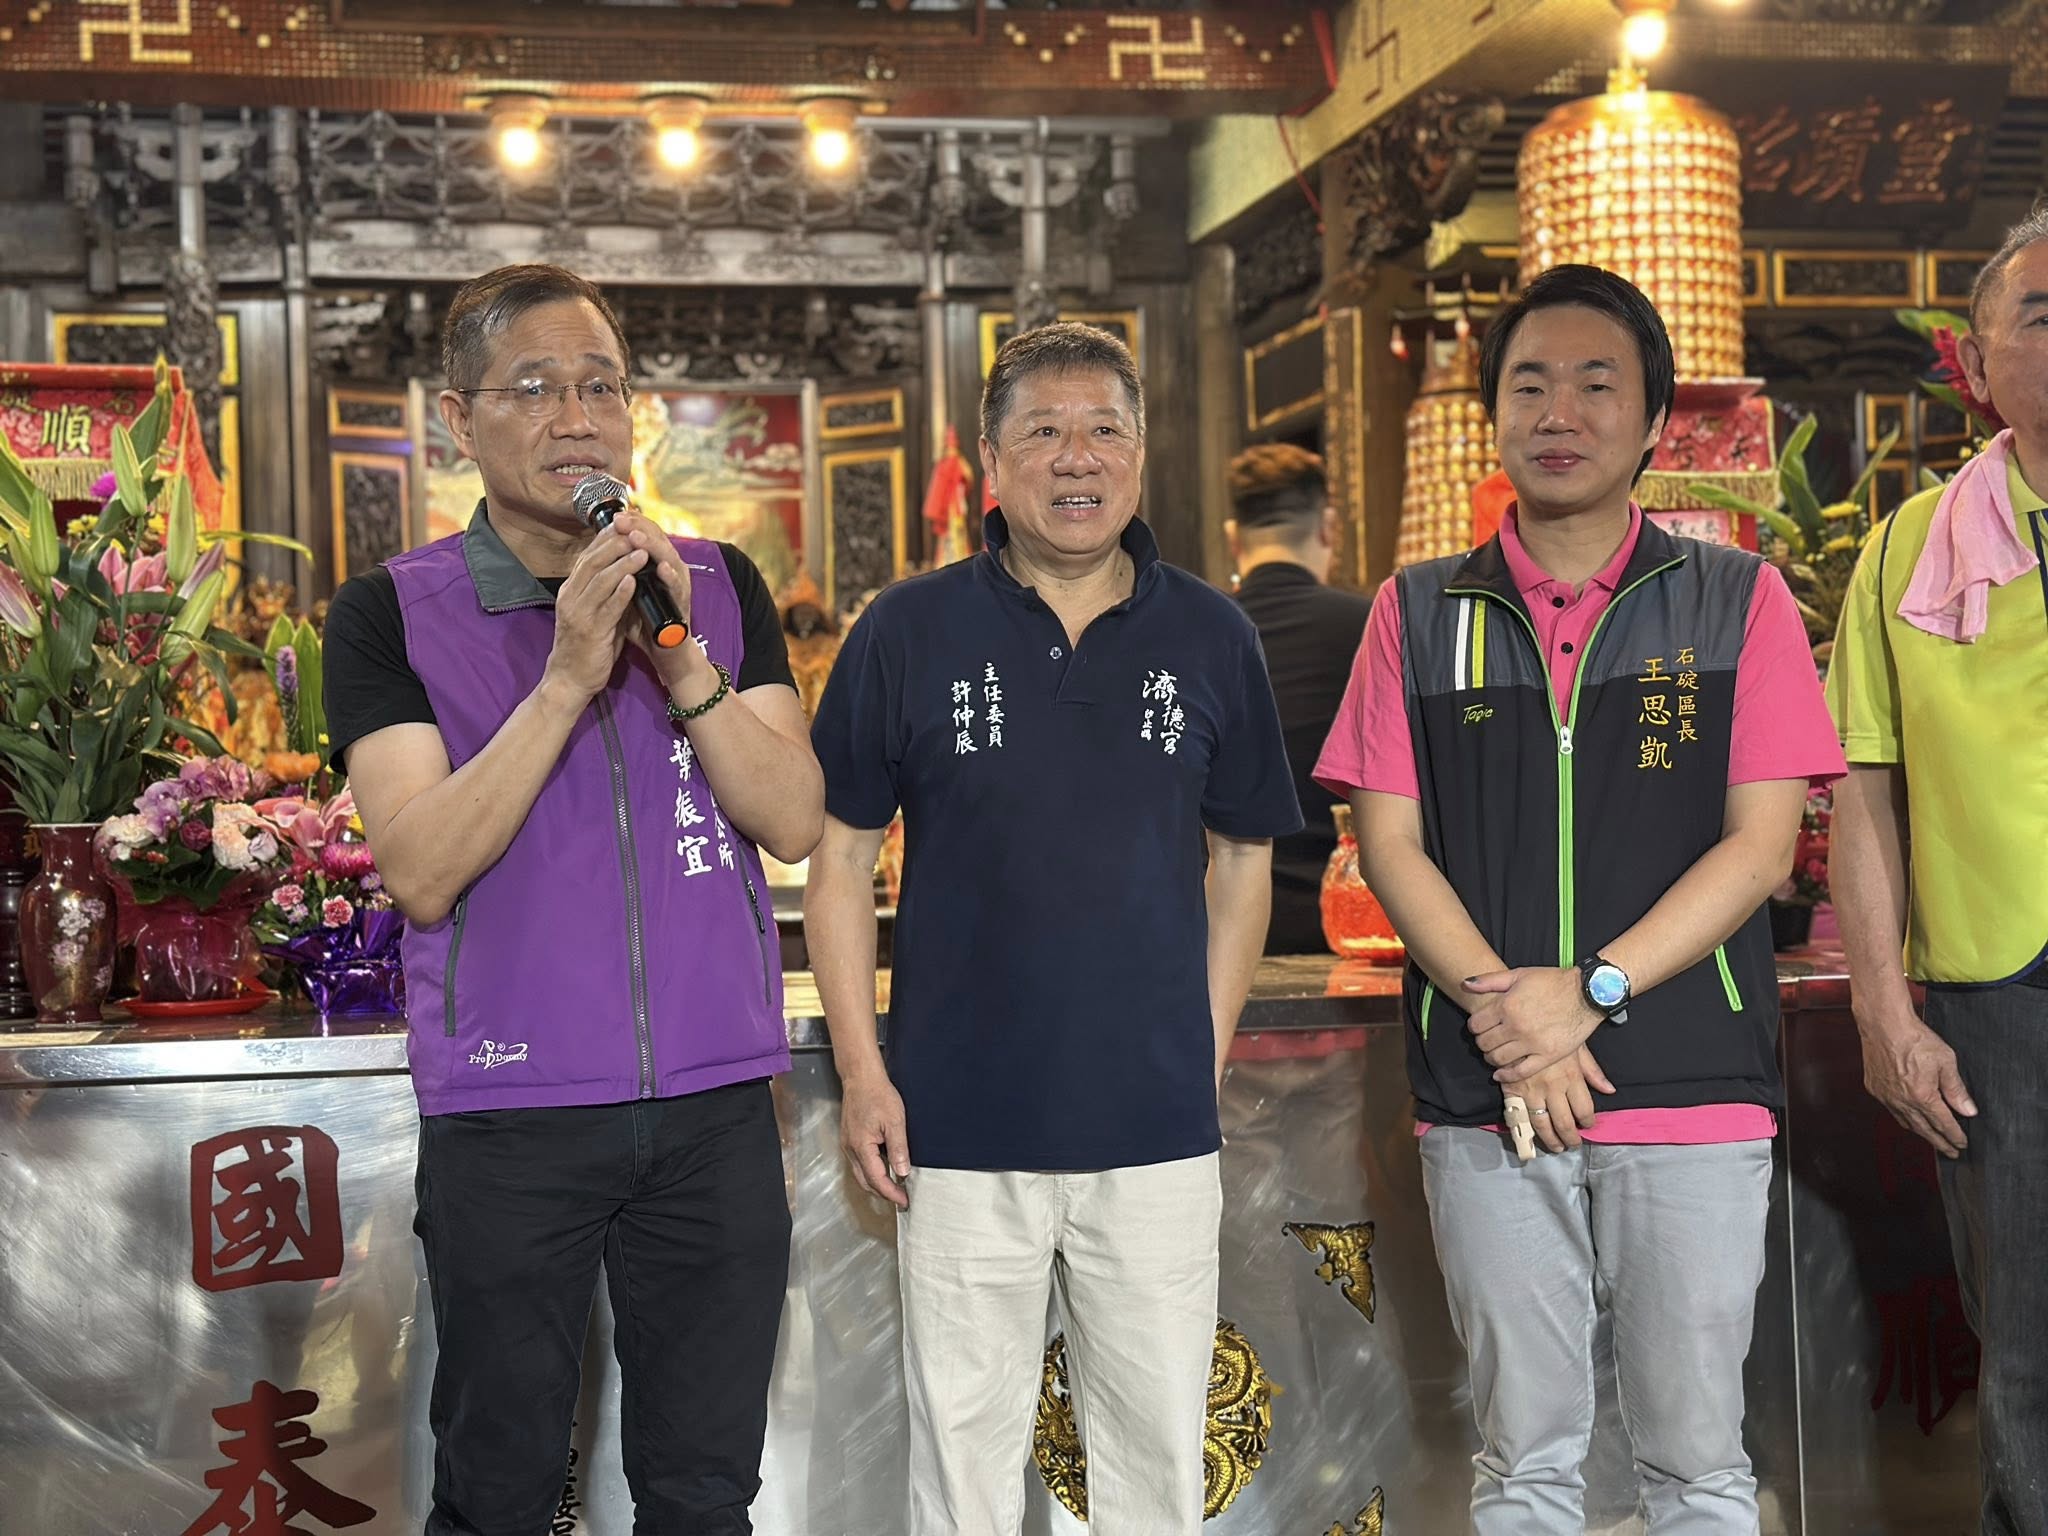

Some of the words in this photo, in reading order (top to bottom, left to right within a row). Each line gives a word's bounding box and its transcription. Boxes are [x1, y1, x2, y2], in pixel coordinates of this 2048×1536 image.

[41, 403, 92, 456] 順
[951, 679, 979, 755] 許仲辰
[983, 662, 1005, 748] 主任委員
[1142, 669, 1186, 755] 濟德宮
[1637, 657, 1672, 769] 王思凱
[1675, 647, 1700, 742] 石碇區長
[669, 736, 713, 877] 葉振宜
[181, 1124, 378, 1536] 國泰
